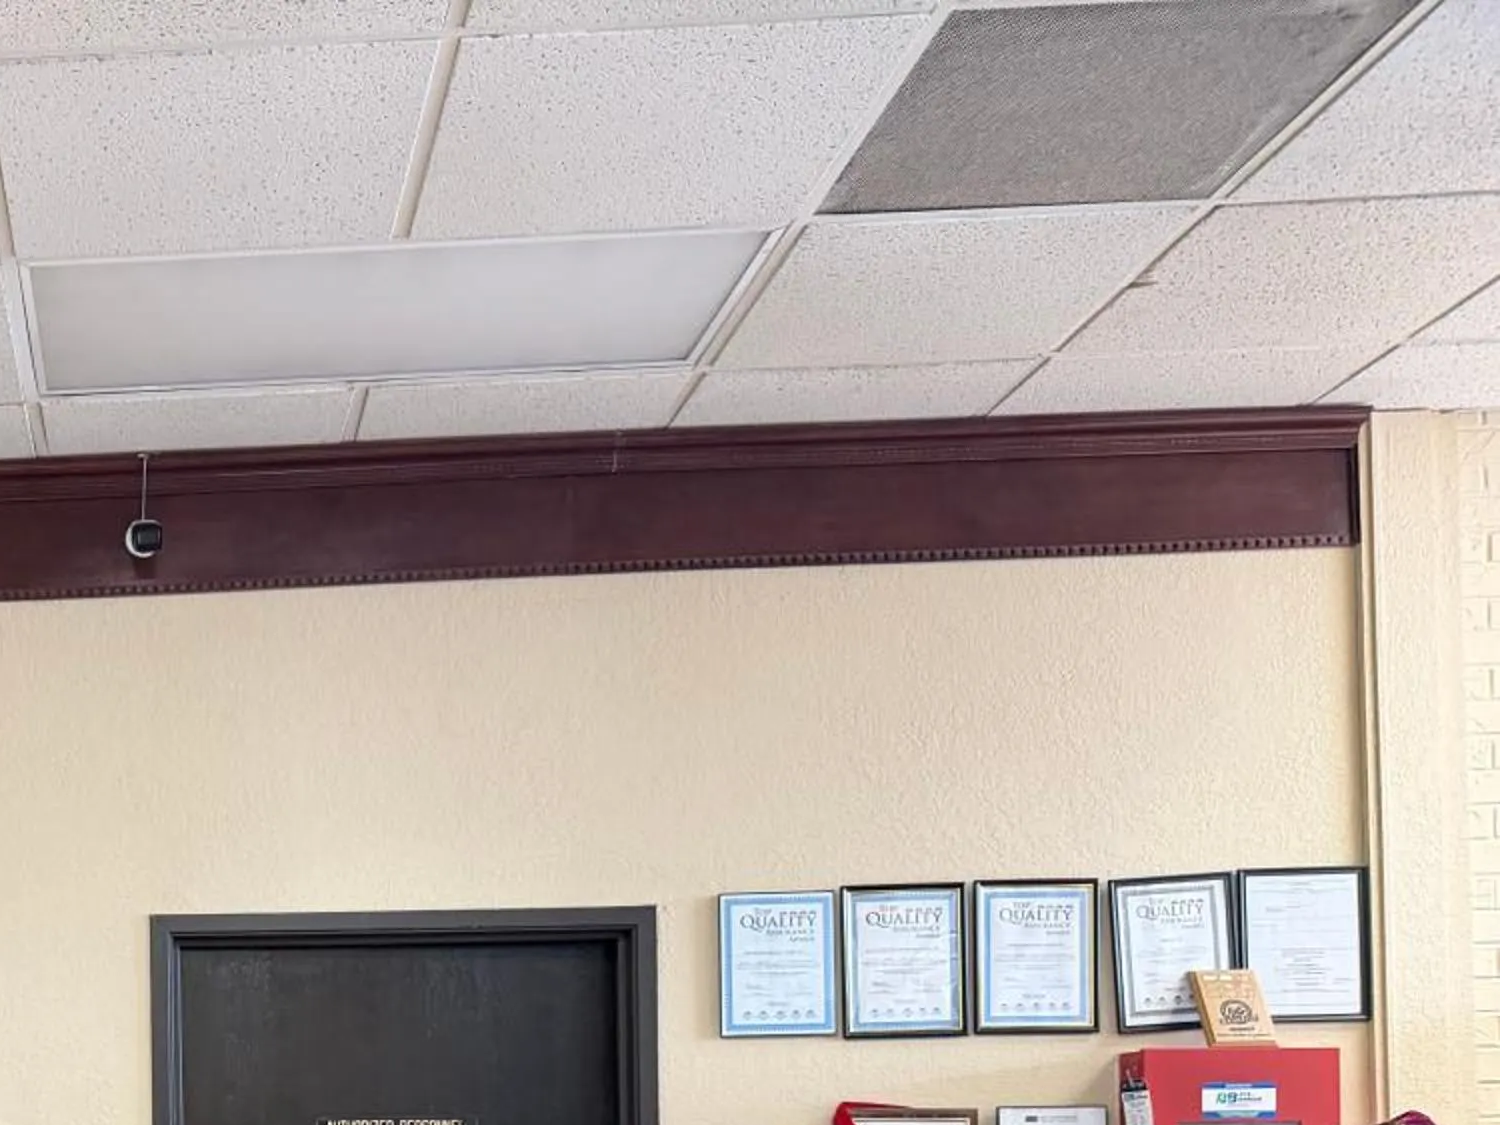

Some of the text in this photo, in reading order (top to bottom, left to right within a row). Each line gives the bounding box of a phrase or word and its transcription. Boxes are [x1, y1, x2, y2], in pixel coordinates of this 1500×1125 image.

[866, 911, 943, 928] QUALITY
[999, 908, 1073, 925] QUALITY
[1135, 902, 1204, 921] QUALITY
[740, 913, 817, 933] QUALITY
